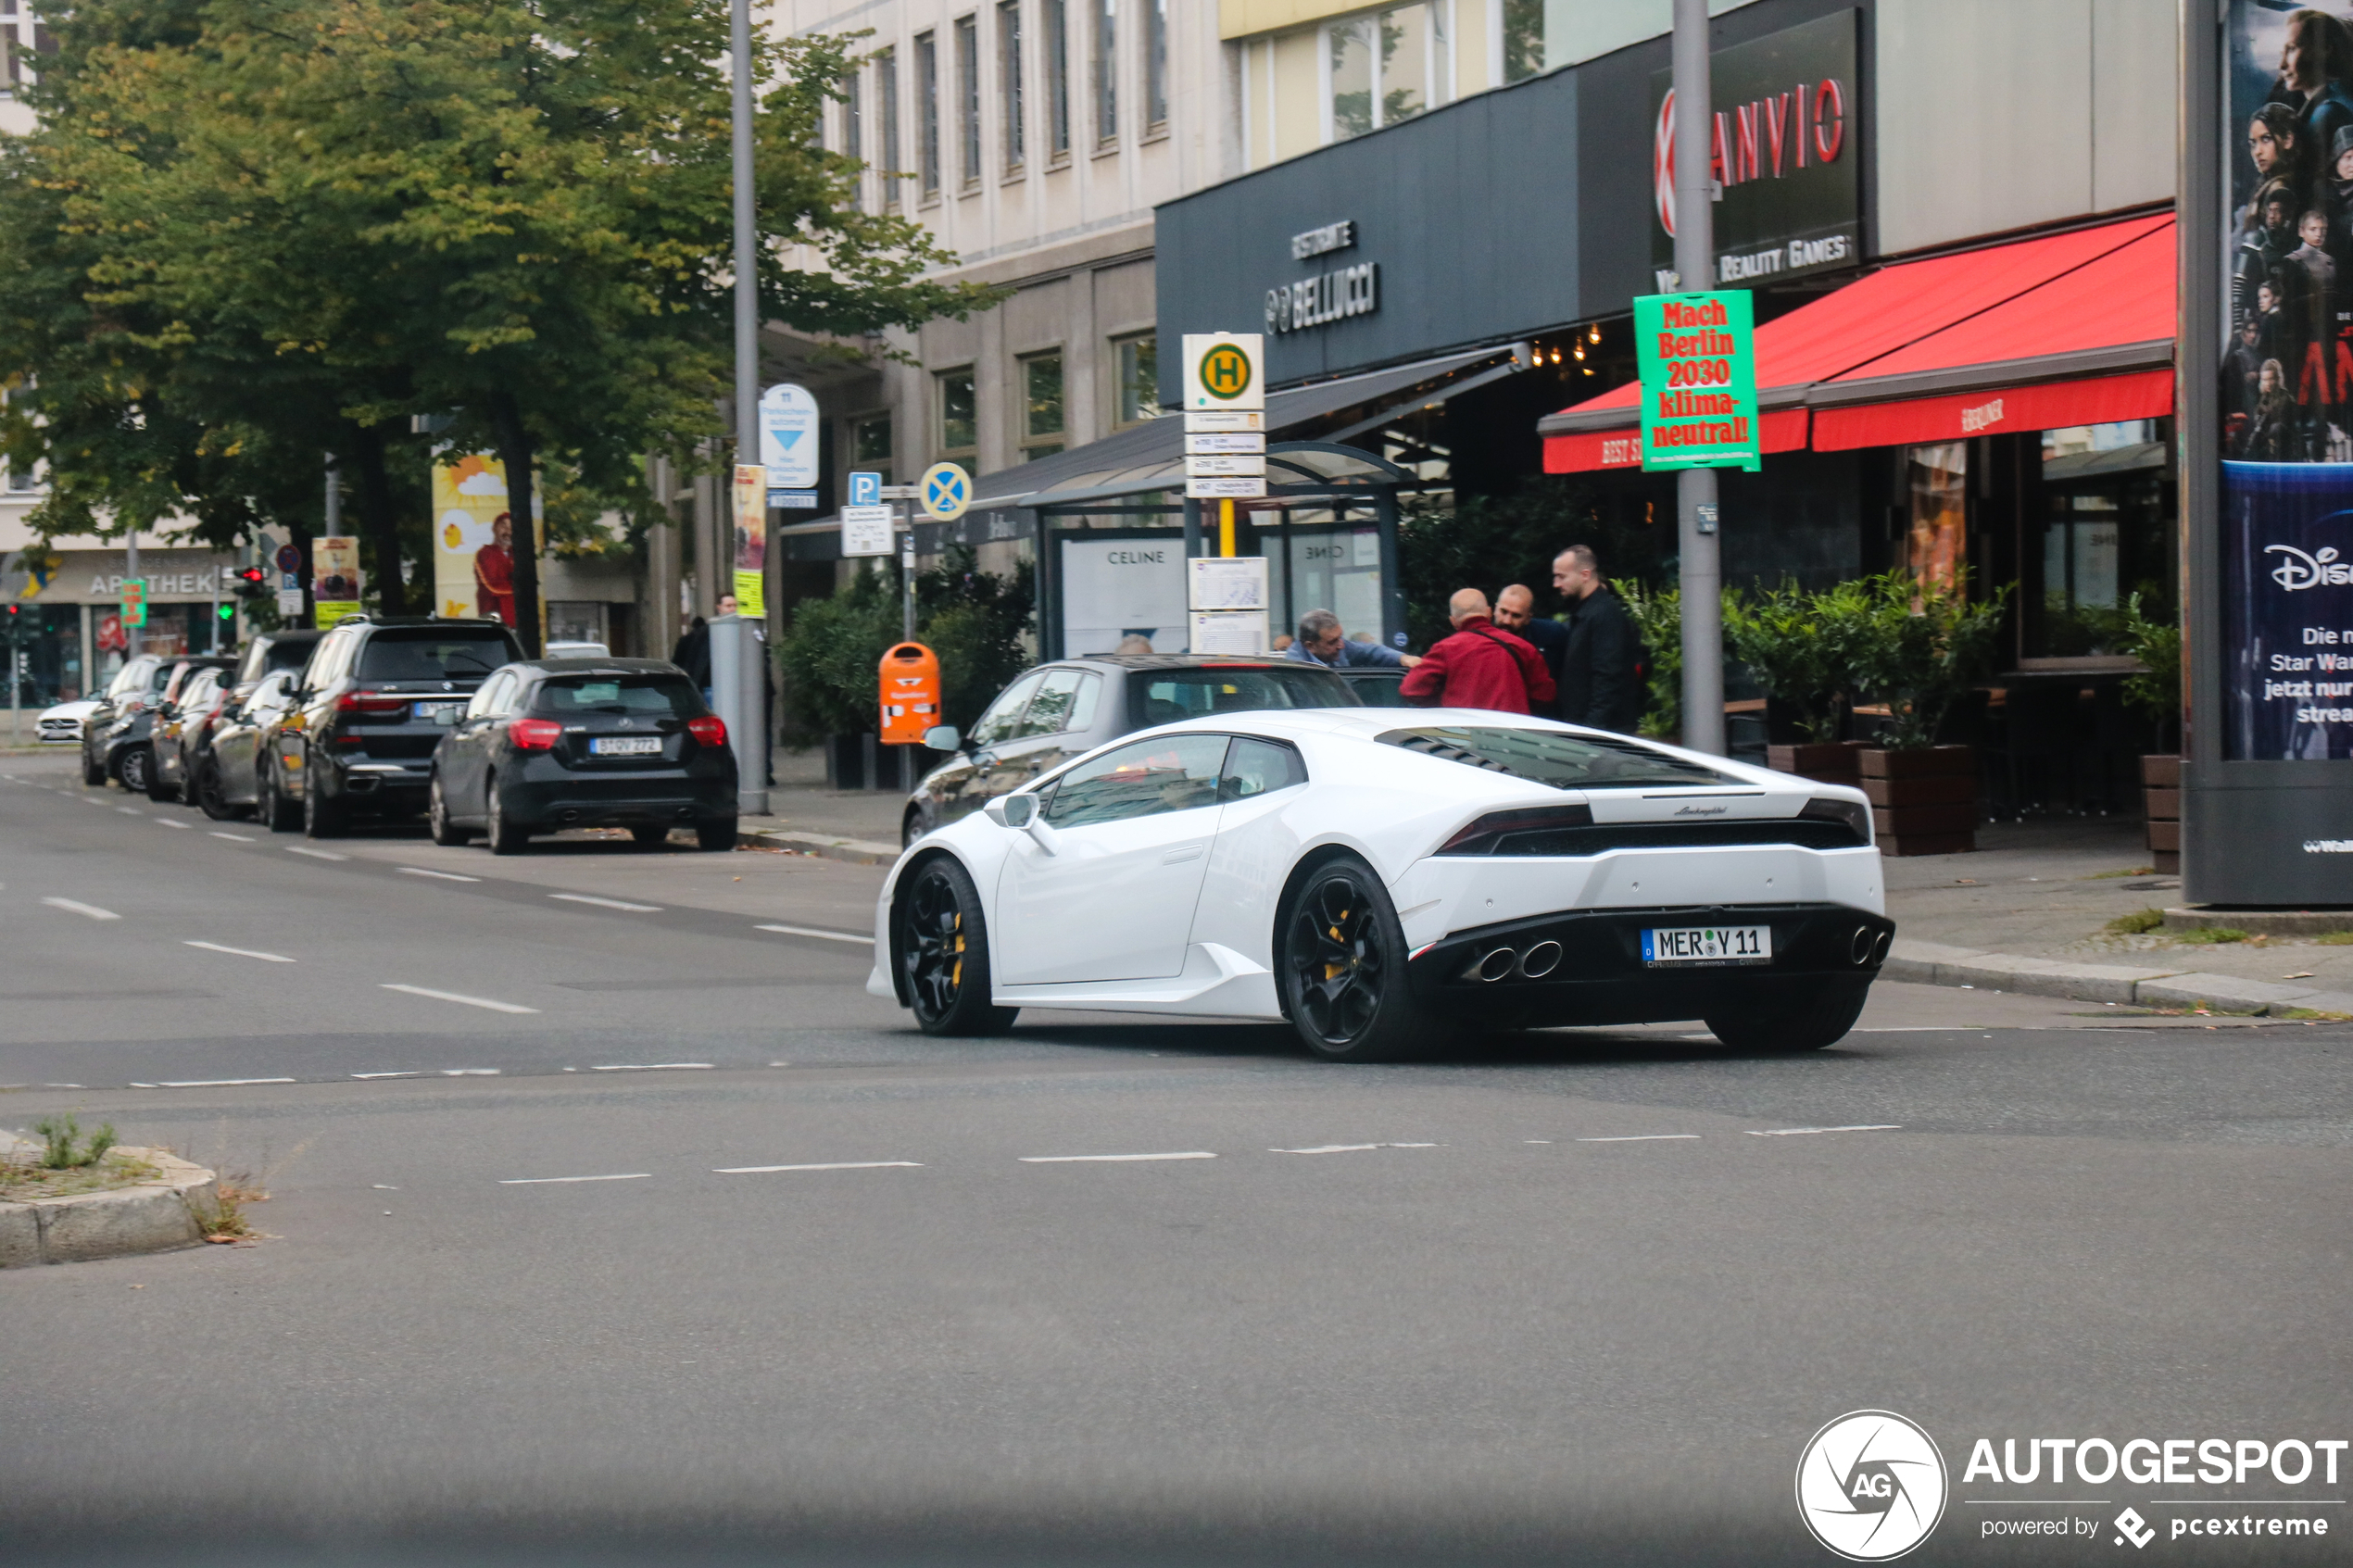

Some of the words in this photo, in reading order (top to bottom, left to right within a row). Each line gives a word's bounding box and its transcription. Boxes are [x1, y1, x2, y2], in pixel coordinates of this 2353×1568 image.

[1711, 78, 1843, 186] ANVIO
[1720, 248, 1782, 282] REALITY
[1789, 235, 1846, 269] GAMES
[1292, 261, 1376, 330] BELLUCCI
[1662, 299, 1729, 329] Mach
[1657, 329, 1736, 359] Berlin
[1214, 357, 1239, 387] H
[1667, 358, 1731, 388] 2030
[1658, 390, 1741, 419] klima-
[1653, 417, 1749, 448] neutral!
[1603, 439, 1629, 464] BEST
[856, 477, 875, 503] P
[1107, 551, 1165, 565] CELINE
[2303, 627, 2339, 645] Die
[2271, 653, 2315, 671] Star
[2264, 679, 2313, 701] jetzt
[2316, 683, 2353, 696] nur
[1659, 931, 1704, 957] MER
[1718, 930, 1730, 955] Y
[1735, 930, 1761, 955] 11
